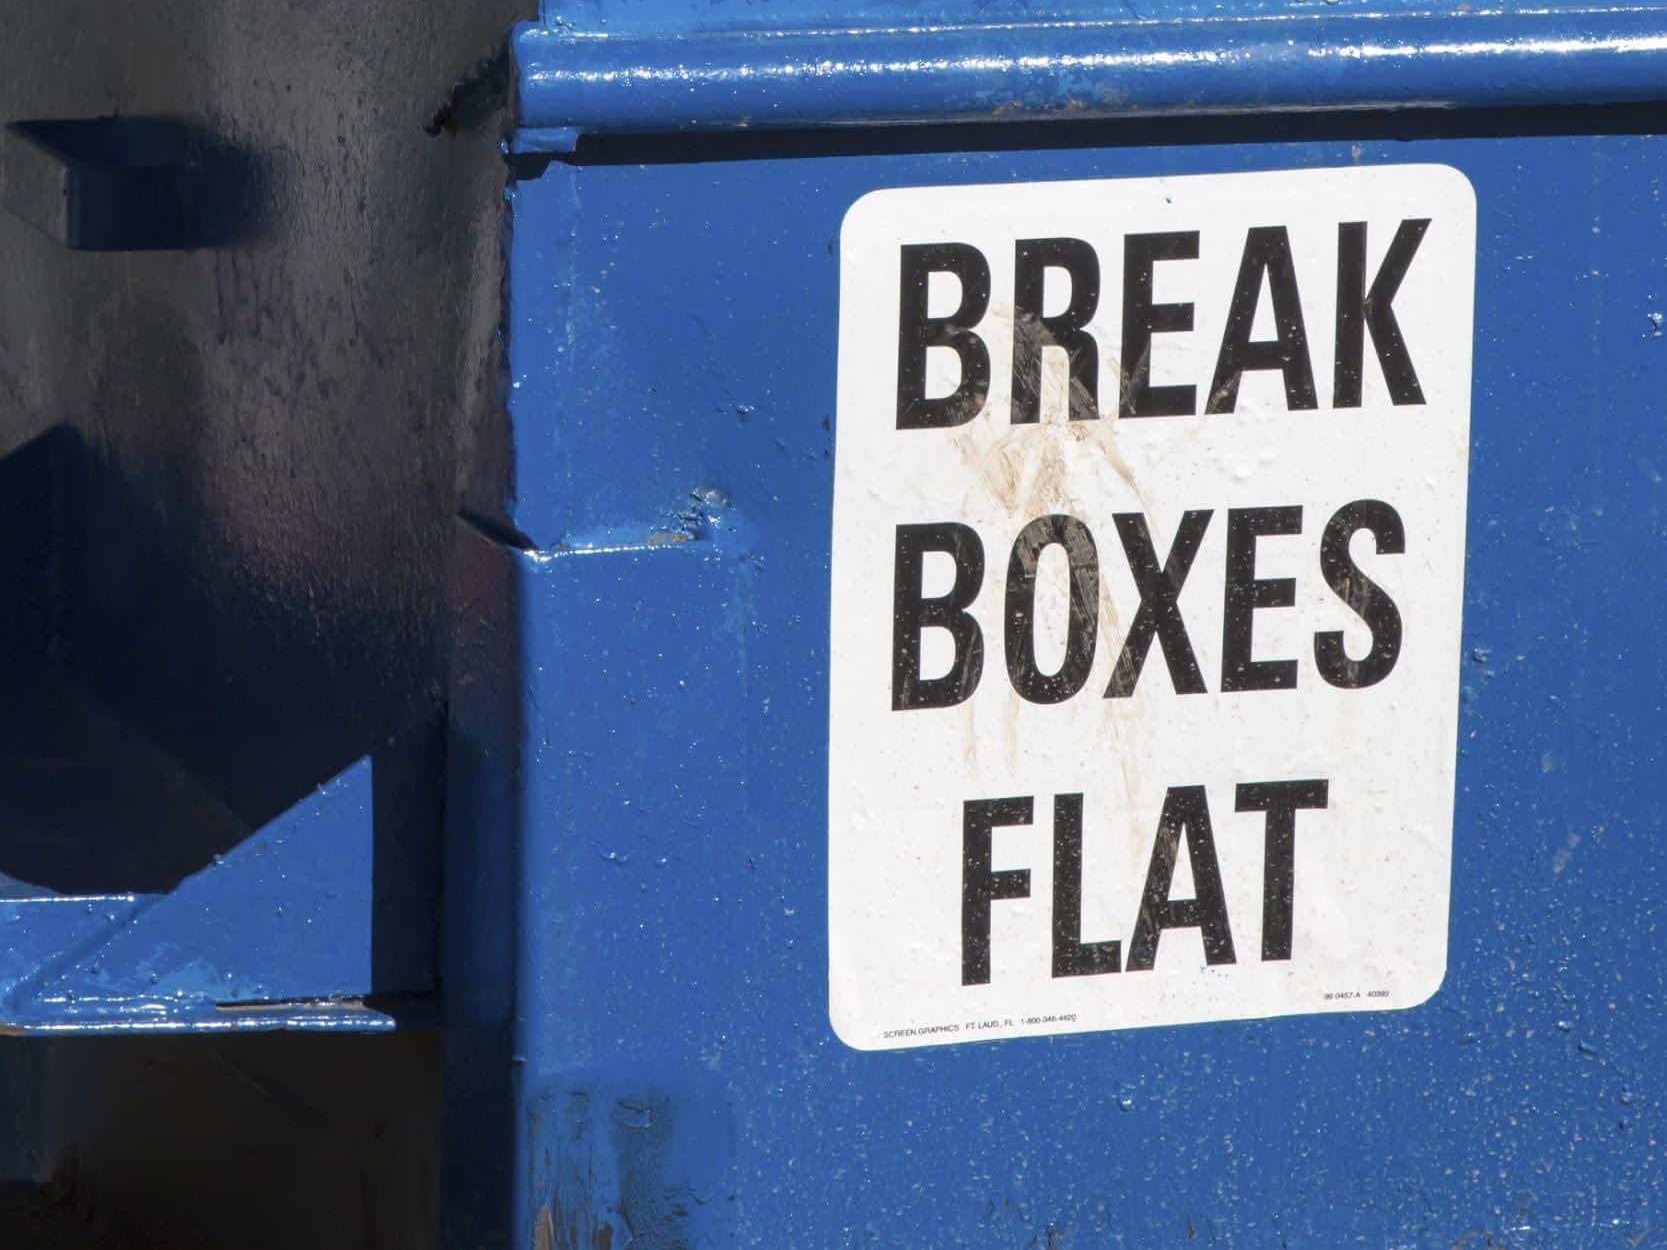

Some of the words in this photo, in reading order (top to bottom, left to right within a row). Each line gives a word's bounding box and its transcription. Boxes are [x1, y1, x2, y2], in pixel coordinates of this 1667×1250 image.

[896, 219, 1432, 430] BREAK
[892, 500, 1405, 711] BOXES
[962, 779, 1329, 985] FLAT
[883, 1029, 917, 1039] SCREEN
[918, 1025, 960, 1036] GRAPHICS
[1004, 1019, 1013, 1027] FL
